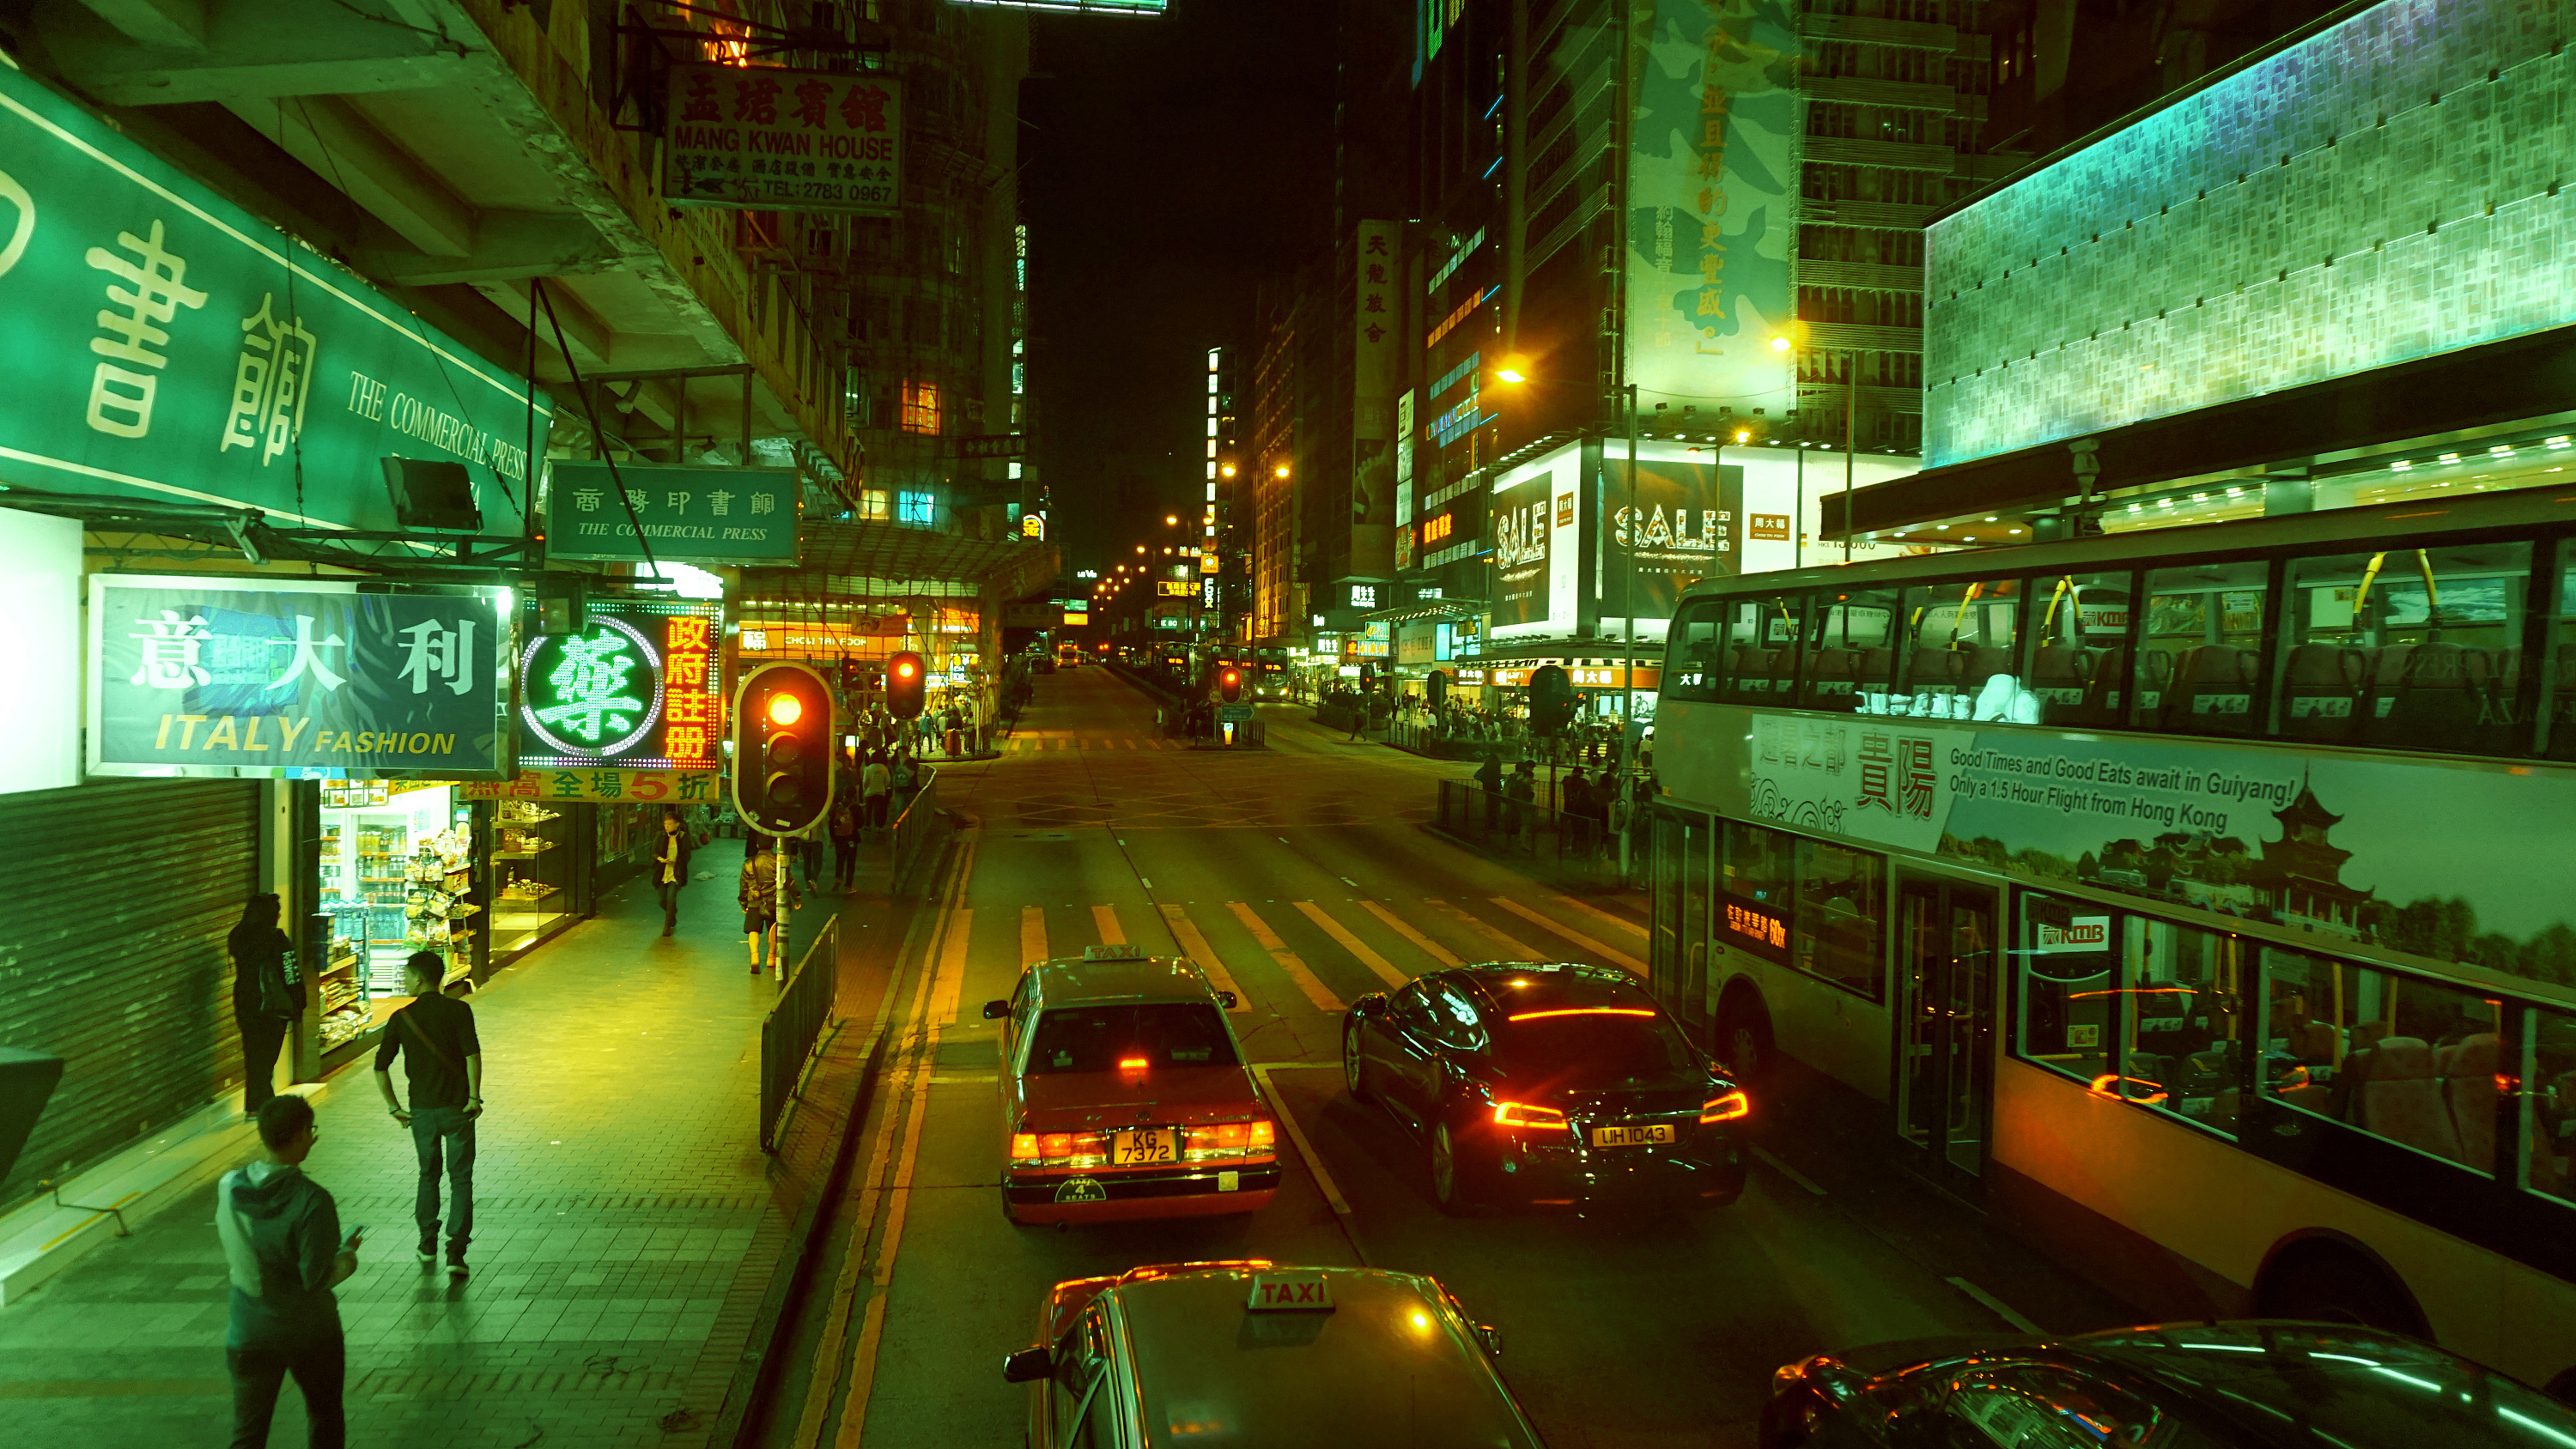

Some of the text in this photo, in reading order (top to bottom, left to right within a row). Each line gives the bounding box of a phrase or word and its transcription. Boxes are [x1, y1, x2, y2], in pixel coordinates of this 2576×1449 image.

[675, 126, 893, 161] MANG KWAN HOUSE
[850, 185, 891, 202] 0967
[348, 371, 527, 481] THE COMMERCIAL PRESS
[579, 523, 767, 541] THE COMMERCIAL PRESS
[1498, 500, 1546, 569] SALE
[1614, 504, 1731, 552] SALE
[1754, 518, 1785, 529] 周大福
[129, 609, 477, 696] 意大利
[535, 627, 643, 741] 藥
[1572, 670, 1613, 684] 周大福
[155, 713, 455, 755] ITALY FASHION
[1856, 732, 1936, 821] 貴陽
[1951, 749, 2295, 807] Good Times and Good Eats await in Guiyang!
[1950, 775, 2227, 834] Only a 1.5 Hour Flight from Hong Kong
[1770, 918, 1786, 949] 60X
[2061, 925, 2105, 944] KMB
[1091, 946, 1140, 959] TAXI
[1133, 1131, 1157, 1148] KG
[1602, 1127, 1666, 1144] UH 1043
[1121, 1145, 1170, 1162] 7372
[1075, 1184, 1085, 1195] 4
[1261, 1282, 1325, 1303] TAXI
